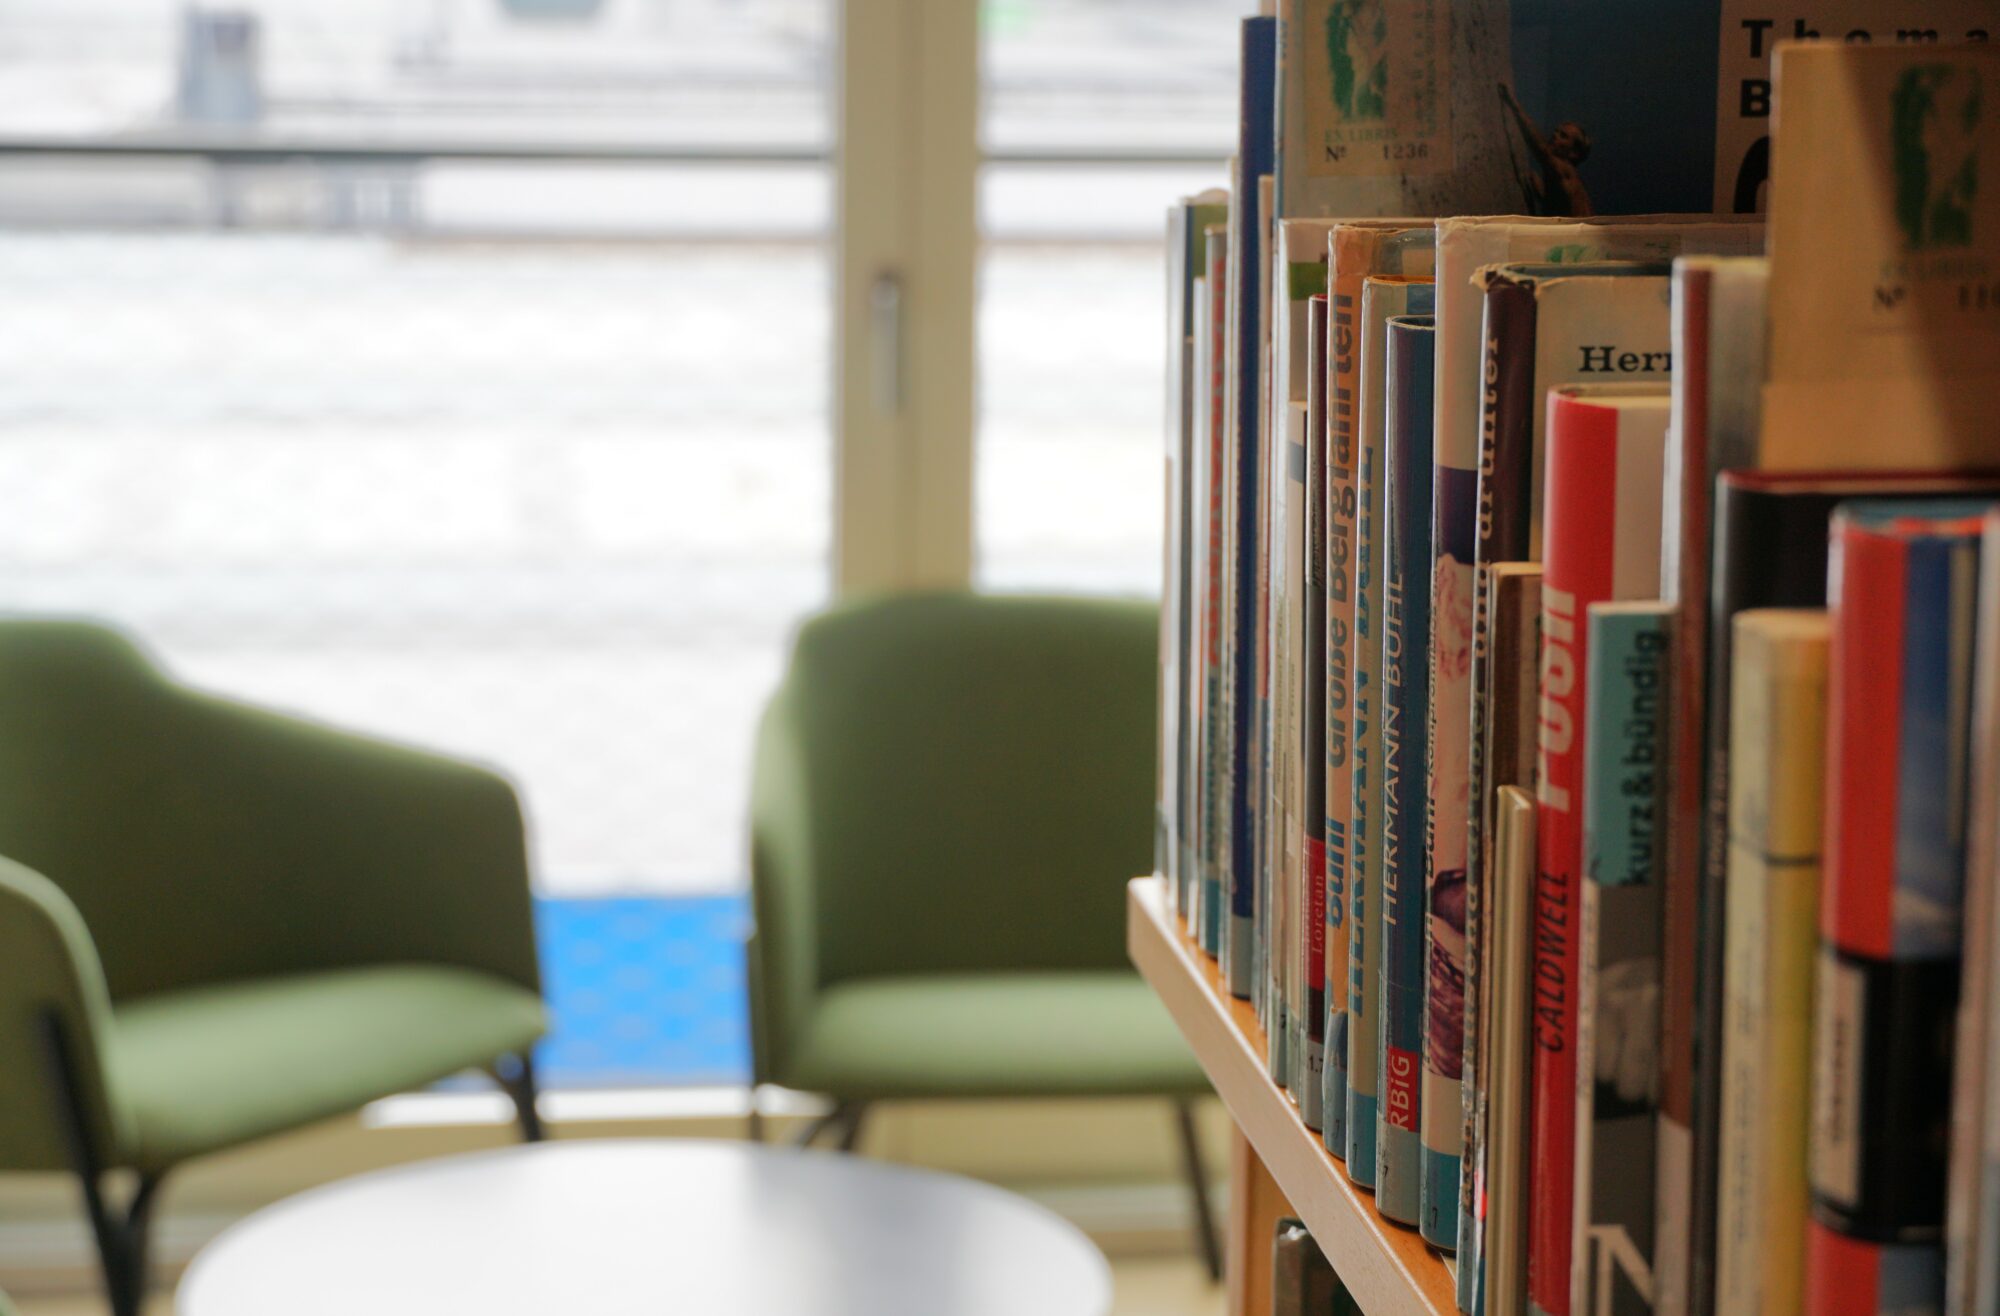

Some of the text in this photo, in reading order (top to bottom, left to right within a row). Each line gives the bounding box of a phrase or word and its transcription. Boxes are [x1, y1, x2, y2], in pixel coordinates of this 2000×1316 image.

[1383, 143, 1428, 160] 1236
[1383, 573, 1403, 926] HERMANN BUHL
[1311, 874, 1323, 955] Loretan
[1534, 871, 1569, 1054] CALDWELL
